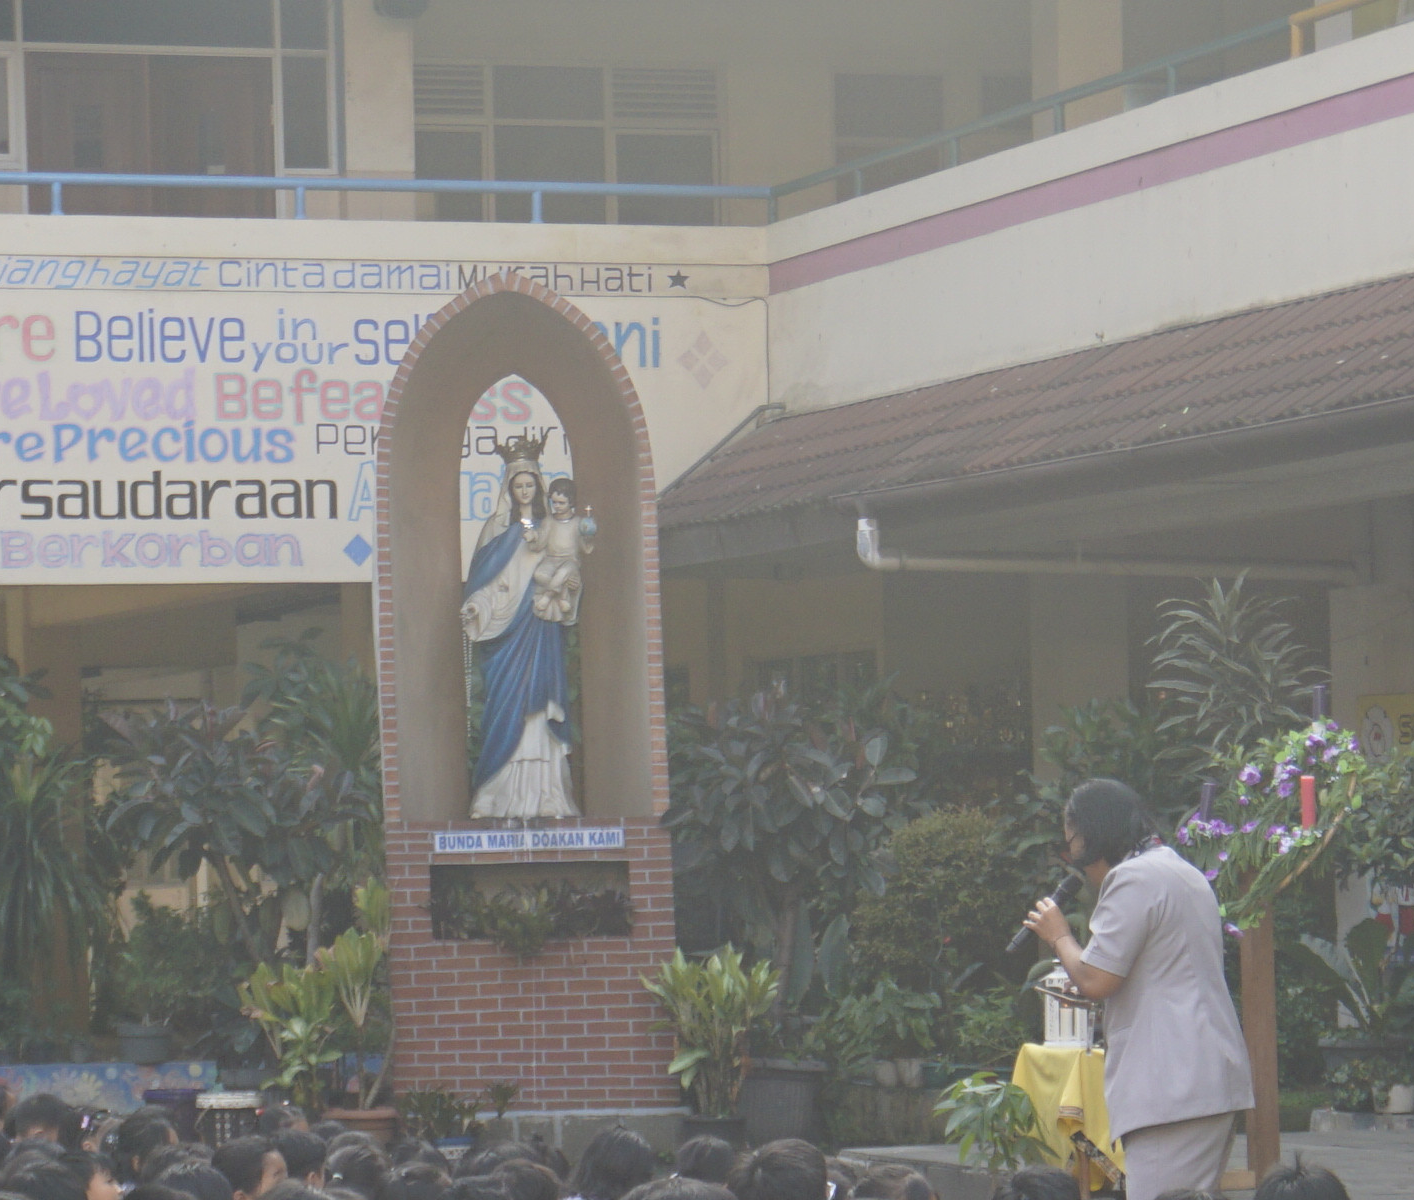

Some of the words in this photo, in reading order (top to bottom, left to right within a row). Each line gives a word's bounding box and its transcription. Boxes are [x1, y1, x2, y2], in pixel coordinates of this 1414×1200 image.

[86, 257, 208, 290] hayat
[218, 260, 325, 288] Cinta
[333, 261, 451, 289] damai
[580, 265, 653, 293] Hati
[74, 308, 246, 364] Believe
[277, 308, 317, 341] in
[250, 341, 350, 372] your
[33, 368, 198, 423] Loved
[52, 420, 297, 465] Precious
[0, 530, 304, 570] Berkorban
[438, 834, 483, 850] BUNDA
[487, 833, 525, 849] MARIA
[531, 831, 585, 848] DOAKAN
[588, 830, 620, 847] KAMI
